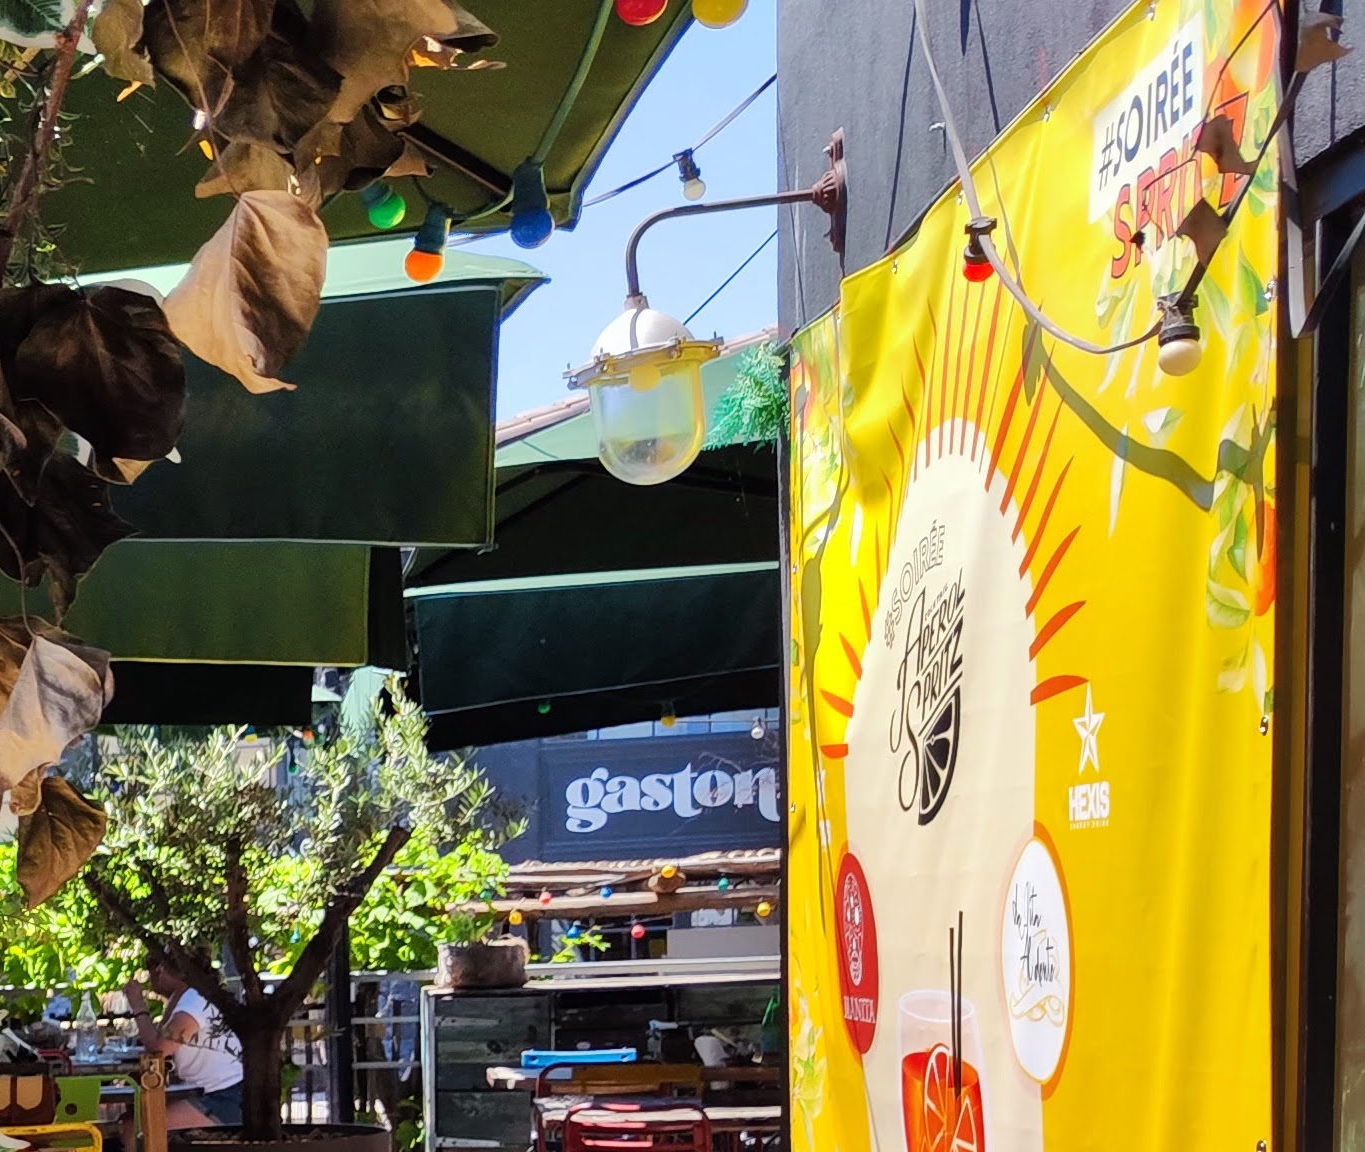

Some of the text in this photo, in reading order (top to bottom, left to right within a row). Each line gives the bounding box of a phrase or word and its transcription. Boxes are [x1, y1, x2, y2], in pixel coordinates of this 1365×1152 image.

[1099, 40, 1193, 191] #SOIRÉE
[884, 519, 945, 649] #SOIRÉE
[566, 762, 781, 833] gaston
[1069, 781, 1110, 822] HEXIS
